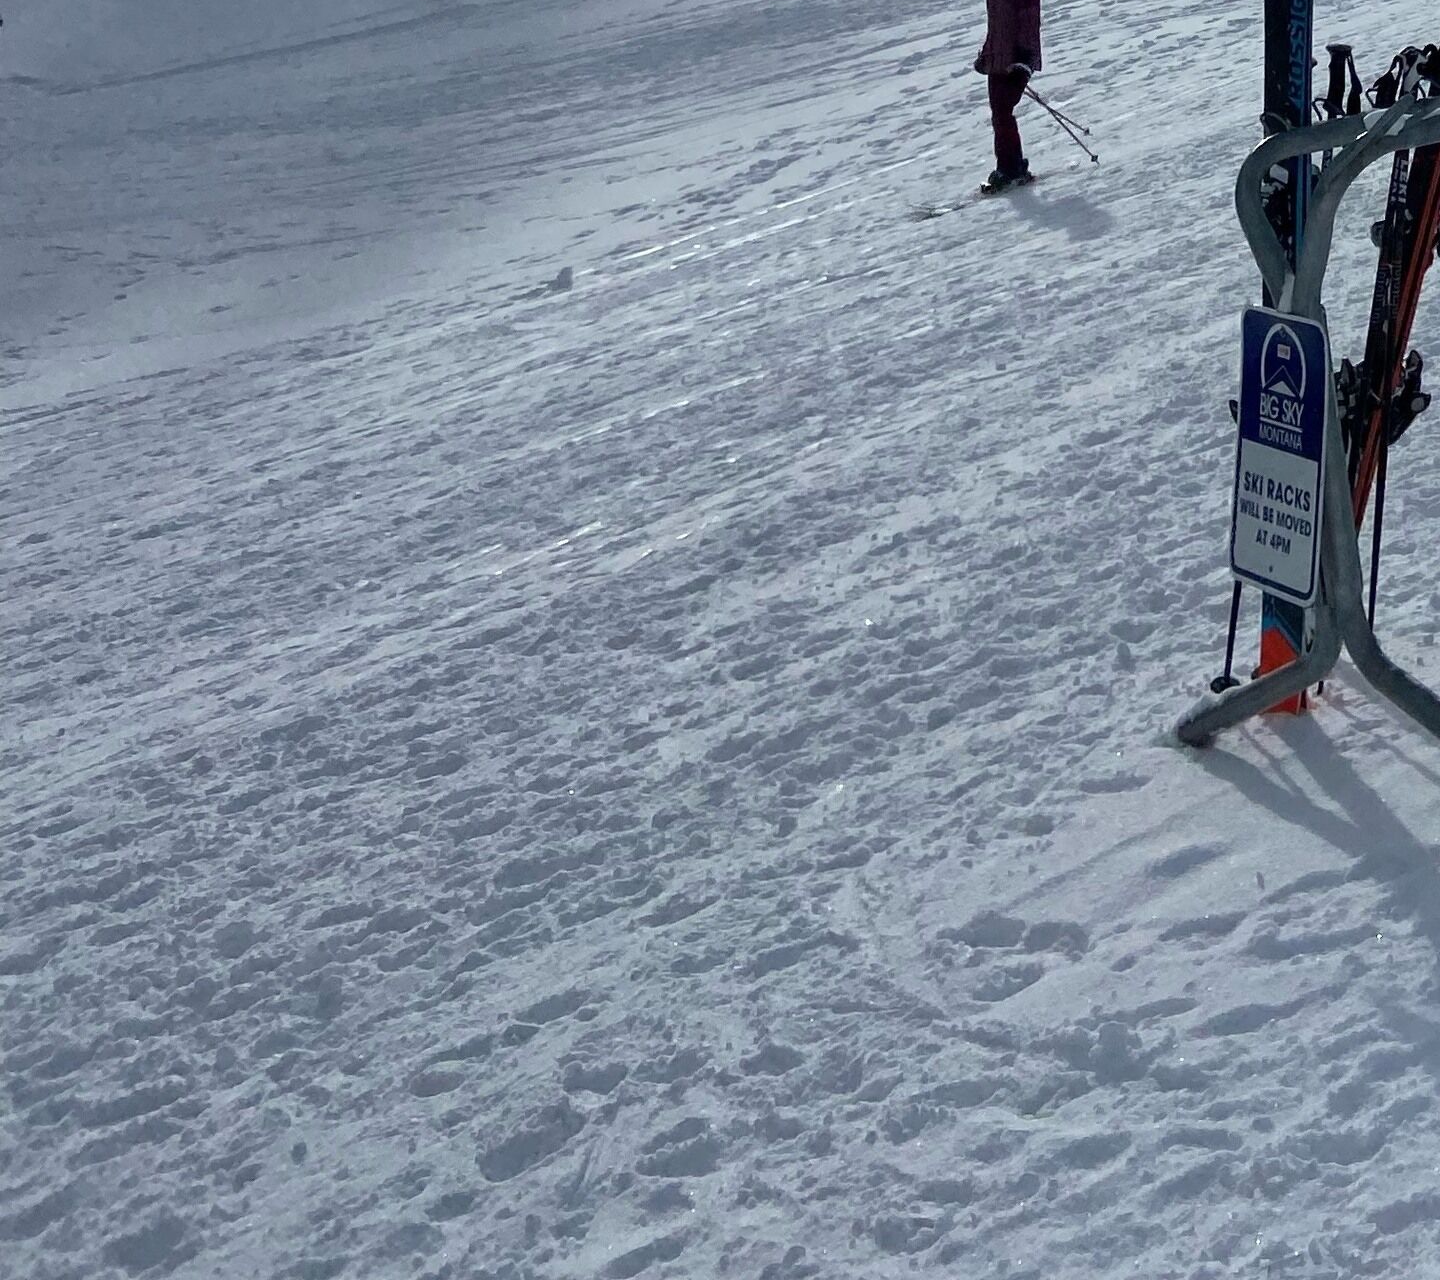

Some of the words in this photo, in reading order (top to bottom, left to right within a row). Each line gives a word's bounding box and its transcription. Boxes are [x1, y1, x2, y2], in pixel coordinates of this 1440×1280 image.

[1259, 392, 1279, 419] BIG
[1281, 399, 1304, 426] SKY
[1259, 422, 1303, 451] MONTANA
[1244, 471, 1264, 496] SKI
[1267, 478, 1311, 512] RACKS
[1240, 498, 1260, 519] WILL
[1263, 506, 1274, 523] BE
[1276, 511, 1311, 536] MOVED
[1256, 529, 1268, 545] AT
[1269, 534, 1291, 555] 4PM
